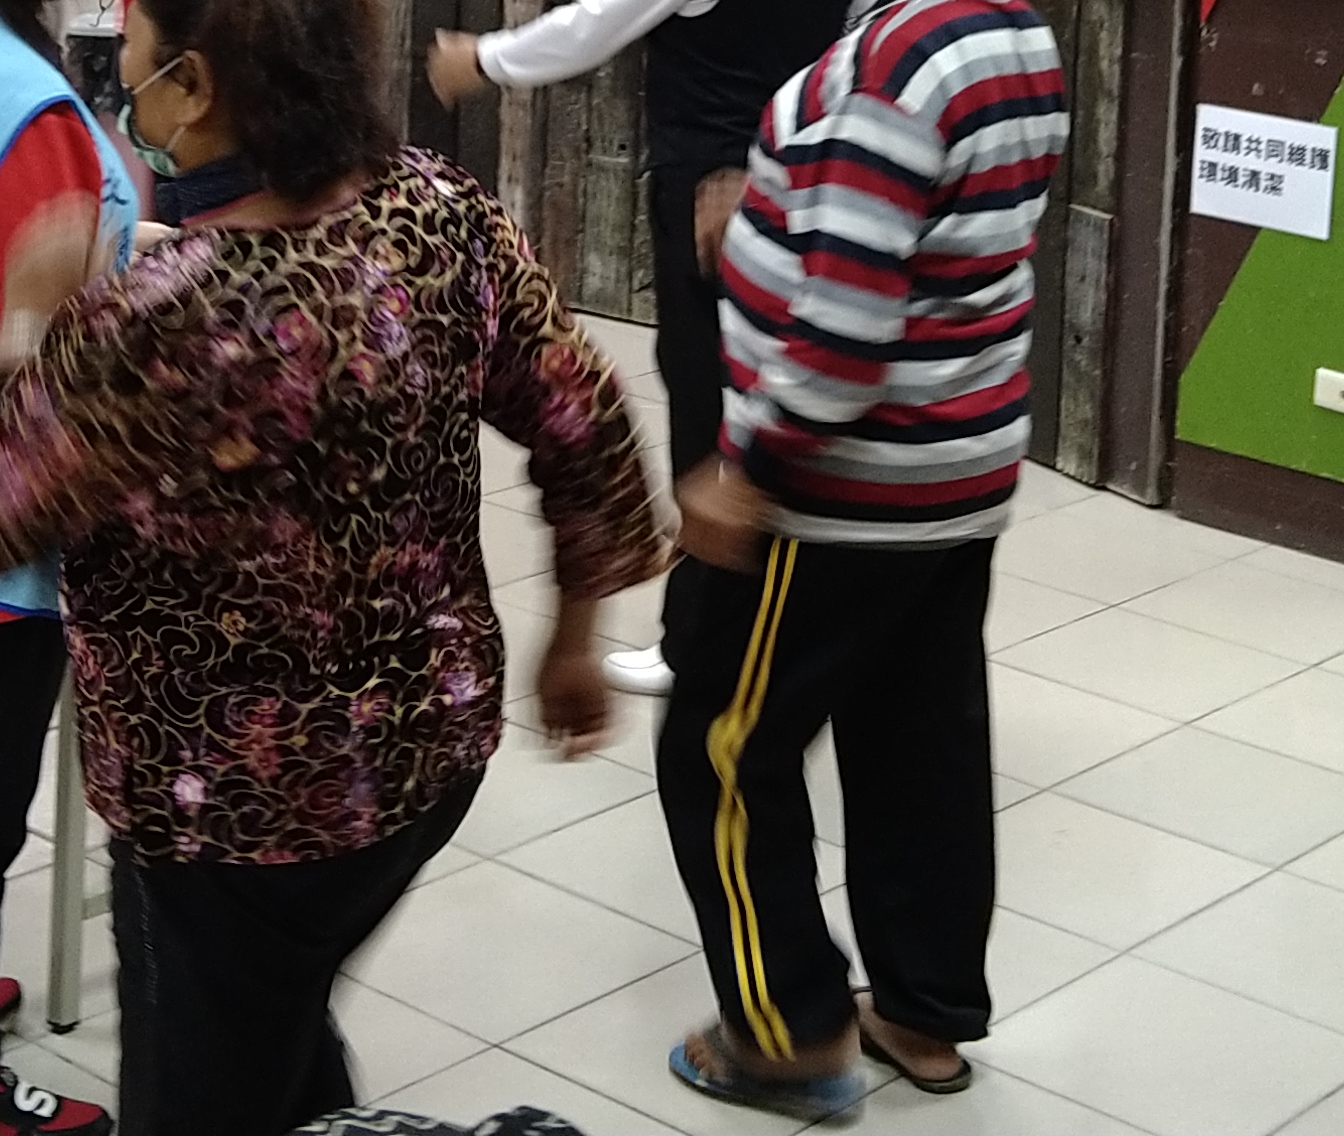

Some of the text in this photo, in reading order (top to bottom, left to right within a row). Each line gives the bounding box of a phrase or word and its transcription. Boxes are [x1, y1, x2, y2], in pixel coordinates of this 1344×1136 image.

[1201, 126, 1332, 172] 敬請共同維護
[1197, 159, 1286, 197] 環境清潔
